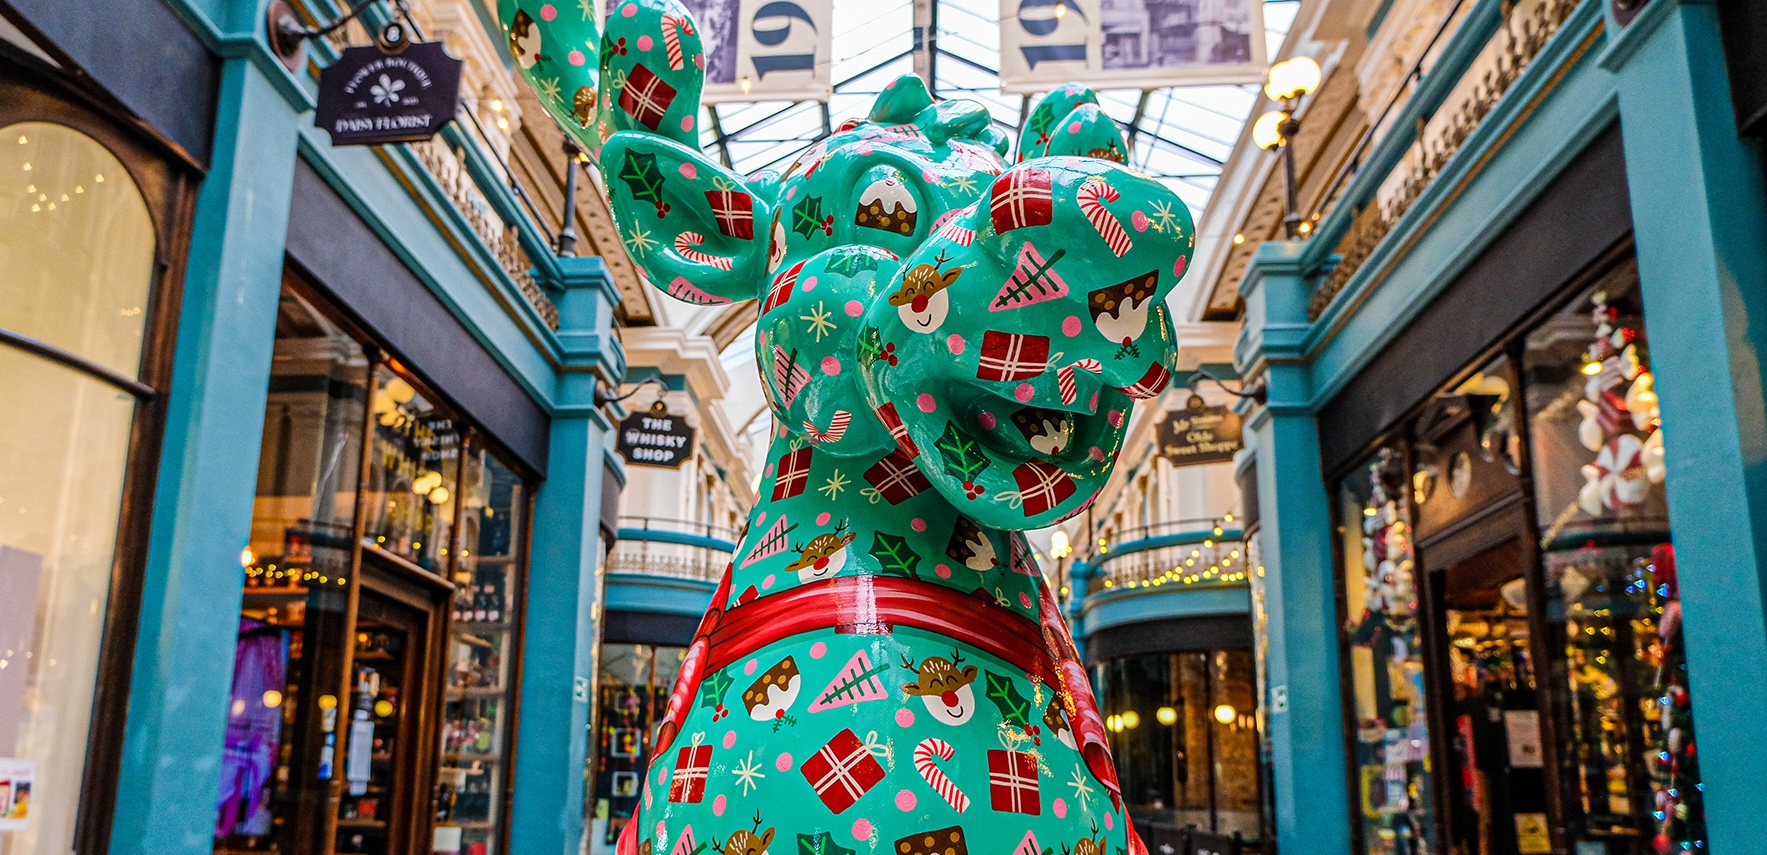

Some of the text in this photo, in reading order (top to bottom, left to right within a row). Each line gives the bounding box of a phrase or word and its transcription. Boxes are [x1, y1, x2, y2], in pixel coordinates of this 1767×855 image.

[335, 114, 433, 133] DAISY FLORIST
[642, 417, 673, 432] THE
[625, 431, 687, 448] WHISKY
[1186, 430, 1215, 444] Olde
[632, 447, 675, 462] SHOP
[1164, 441, 1239, 457] Sweet Shoppe
